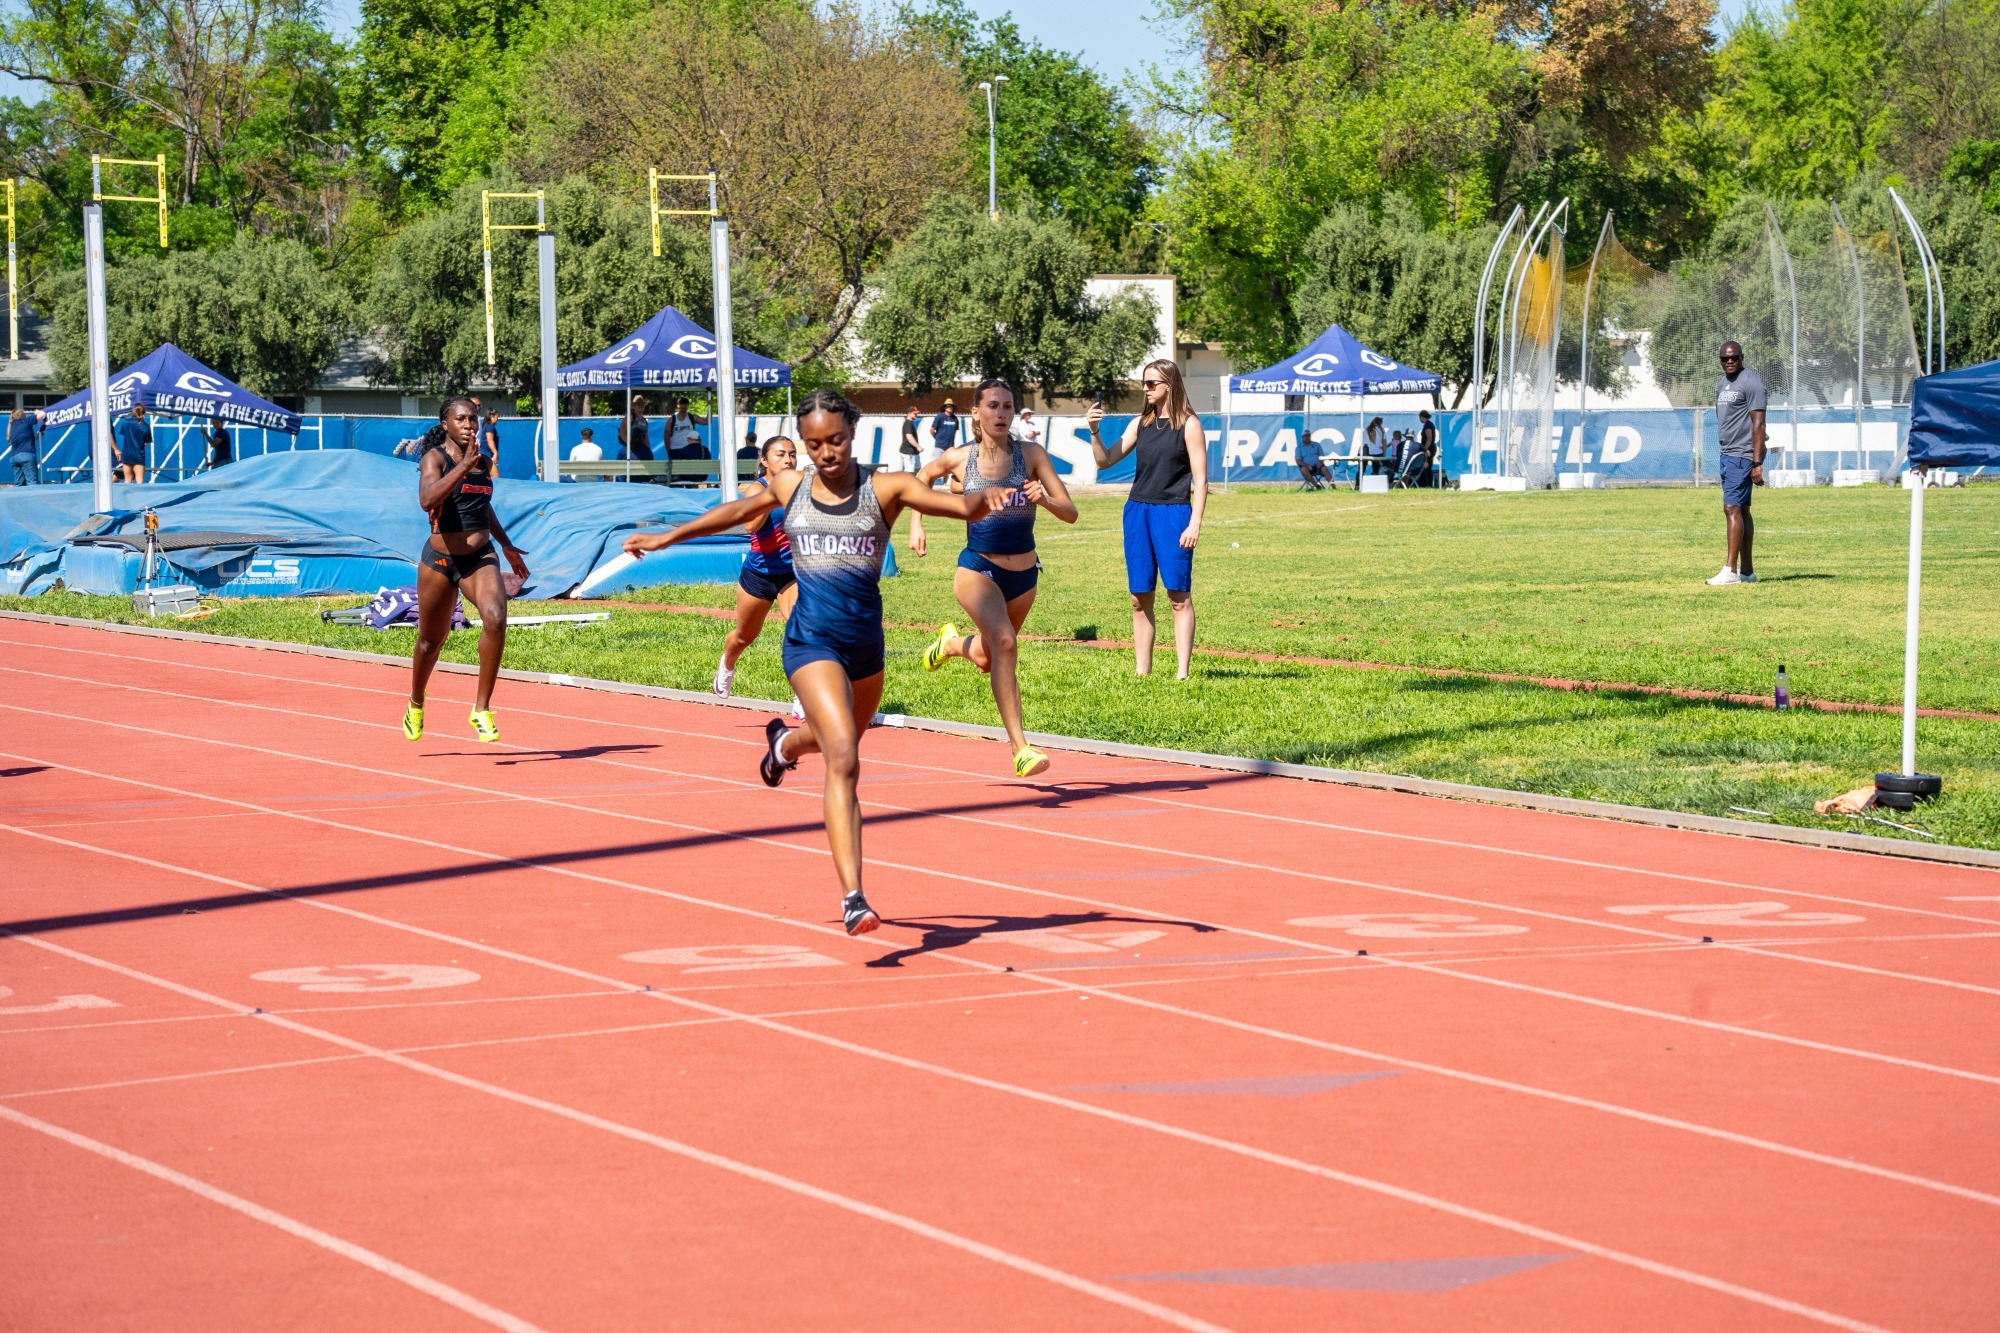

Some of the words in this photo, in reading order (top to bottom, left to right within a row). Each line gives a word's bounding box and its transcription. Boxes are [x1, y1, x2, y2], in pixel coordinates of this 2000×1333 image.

[567, 370, 587, 387] DAVIS
[588, 370, 623, 385] ATHLETICS
[643, 370, 659, 384] UC
[663, 368, 702, 383] DAVIS
[707, 368, 778, 383] ALETICS
[1240, 379, 1254, 392] UC
[1255, 380, 1288, 393] DAVIS
[1292, 379, 1351, 393] ATHLETICS
[57, 403, 83, 424] DAVIS
[87, 394, 132, 417] AETICS
[156, 393, 171, 410] UC
[175, 396, 216, 415] DAVIS
[219, 402, 289, 430] ATHLETICS
[1467, 426, 1642, 464] FIELD
[797, 534, 820, 556] UC
[824, 534, 875, 556] DAVIS
[217, 559, 300, 578] UCS
